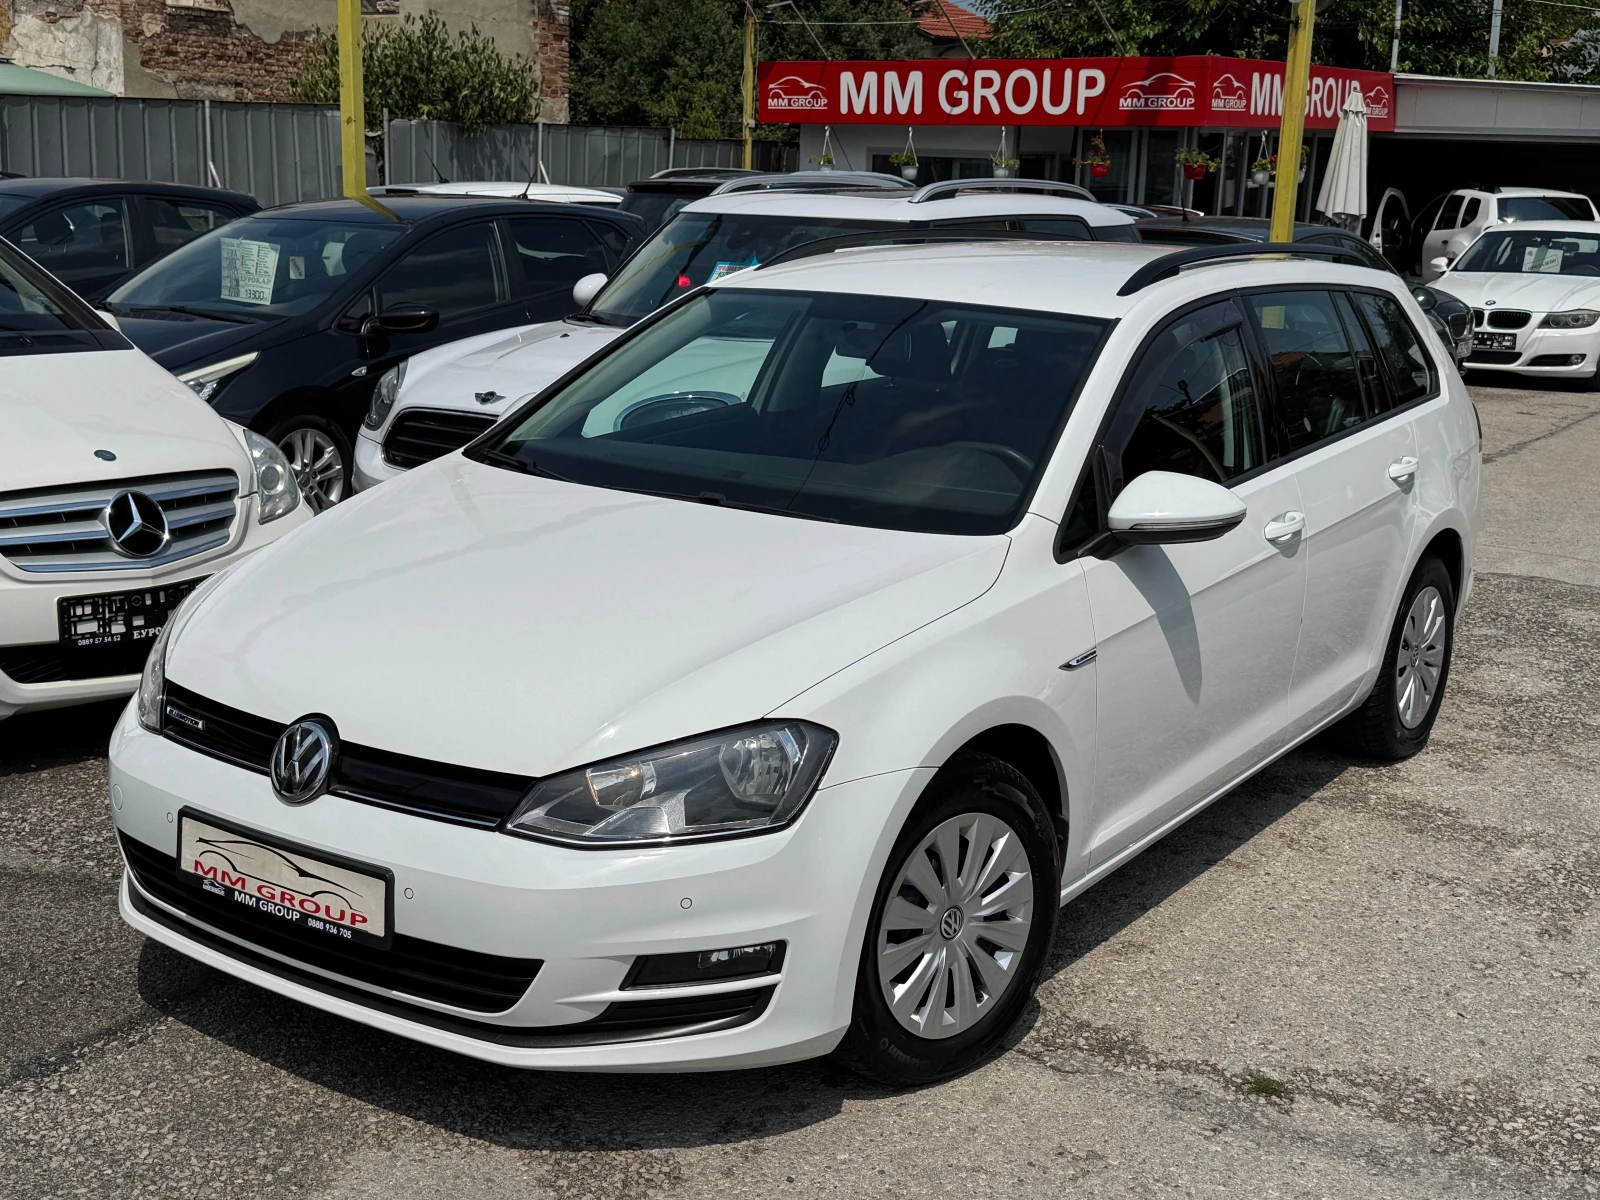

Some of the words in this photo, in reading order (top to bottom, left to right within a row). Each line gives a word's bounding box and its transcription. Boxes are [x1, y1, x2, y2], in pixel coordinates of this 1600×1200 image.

[840, 71, 923, 115] MM
[938, 68, 1106, 115] GROUP
[768, 98, 788, 107] MM
[791, 98, 828, 107] GROUP
[1119, 98, 1145, 108] MM
[1148, 98, 1195, 108] GROUP
[1211, 98, 1224, 108] MM
[1225, 99, 1246, 109] GROUP
[78, 636, 93, 646] 0889
[95, 634, 102, 644] 57
[104, 633, 112, 643] 54
[113, 632, 121, 641] 52
[194, 860, 246, 890] MM
[256, 884, 368, 926] GROUP
[234, 890, 256, 908] MM
[259, 900, 300, 921] GROUP
[308, 918, 323, 930] 0888
[326, 924, 337, 934] 936
[340, 928, 351, 939] 705
